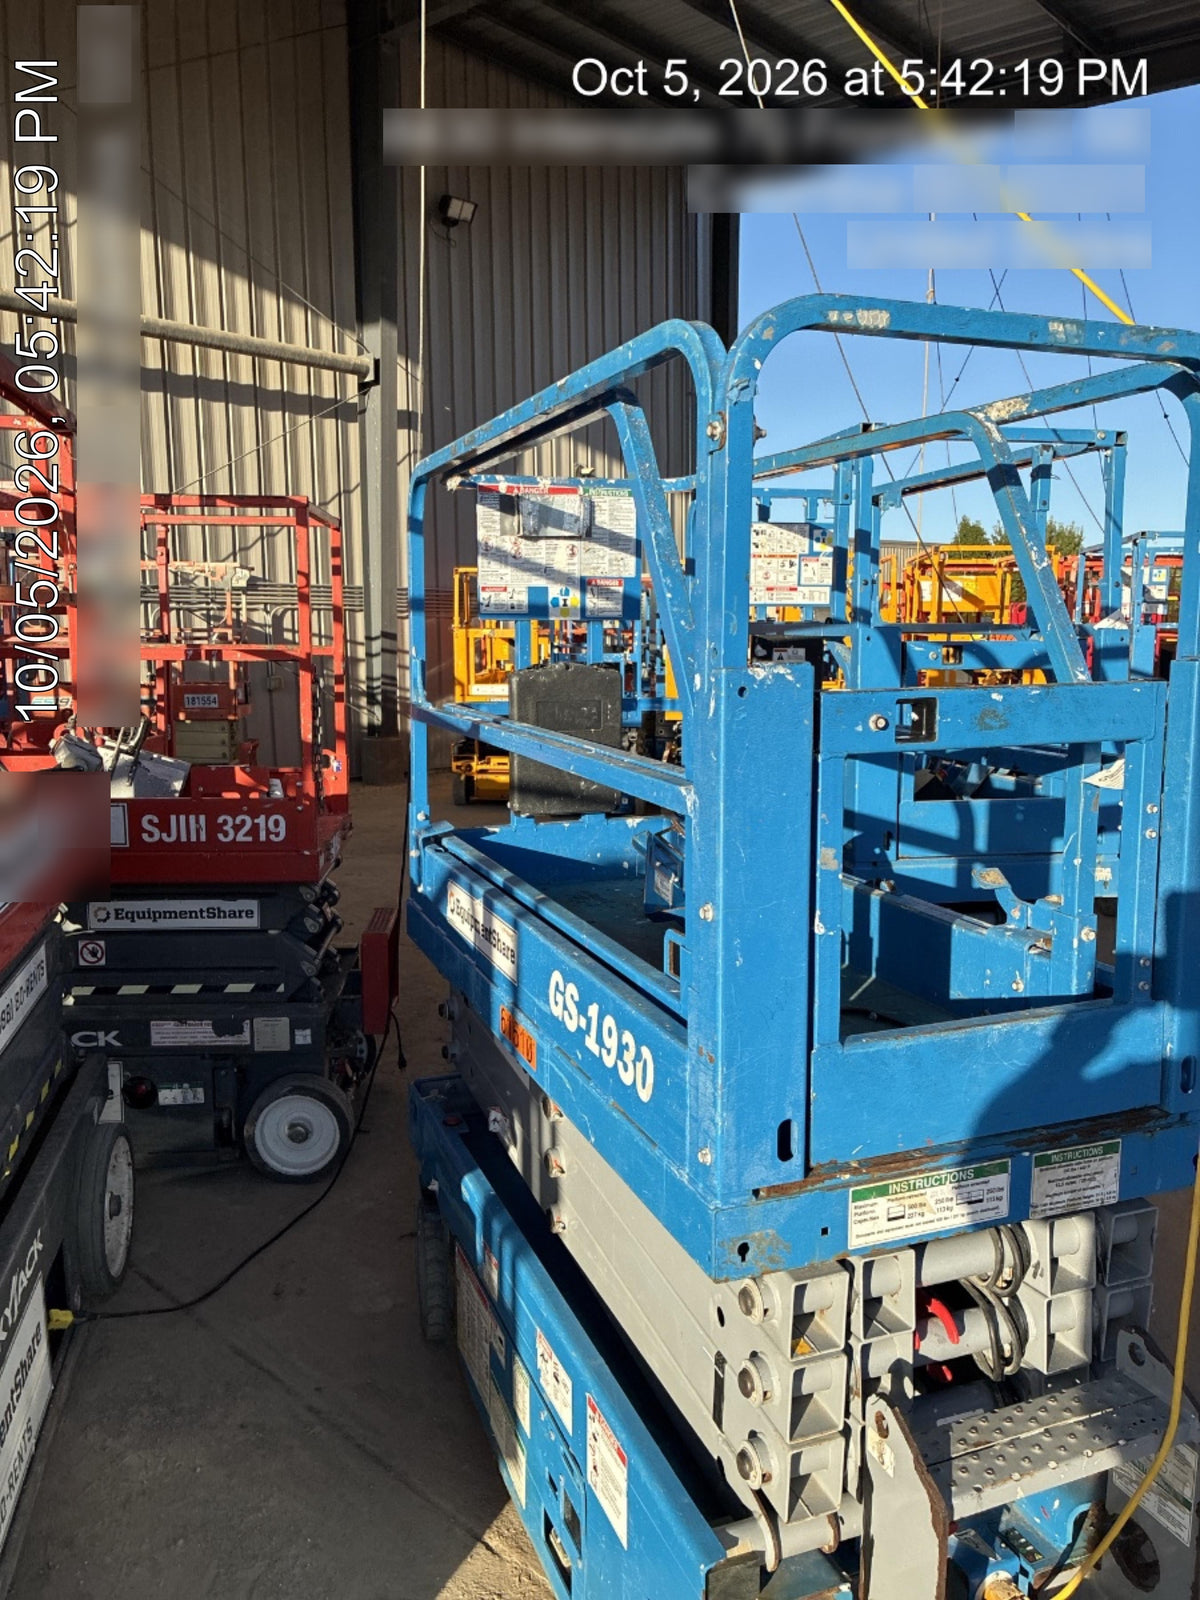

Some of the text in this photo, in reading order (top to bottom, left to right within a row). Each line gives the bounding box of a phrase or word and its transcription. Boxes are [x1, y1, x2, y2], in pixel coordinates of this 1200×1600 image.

[185, 695, 217, 708] 181554
[217, 814, 287, 842] 3219
[113, 906, 255, 923] EquipmentShare
[71, 1030, 123, 1048] CK
[548, 969, 655, 1104] GS-1930
[1051, 1145, 1104, 1163] INSTRUCTIONS
[888, 1168, 975, 1195] INSTRUCTIONS
